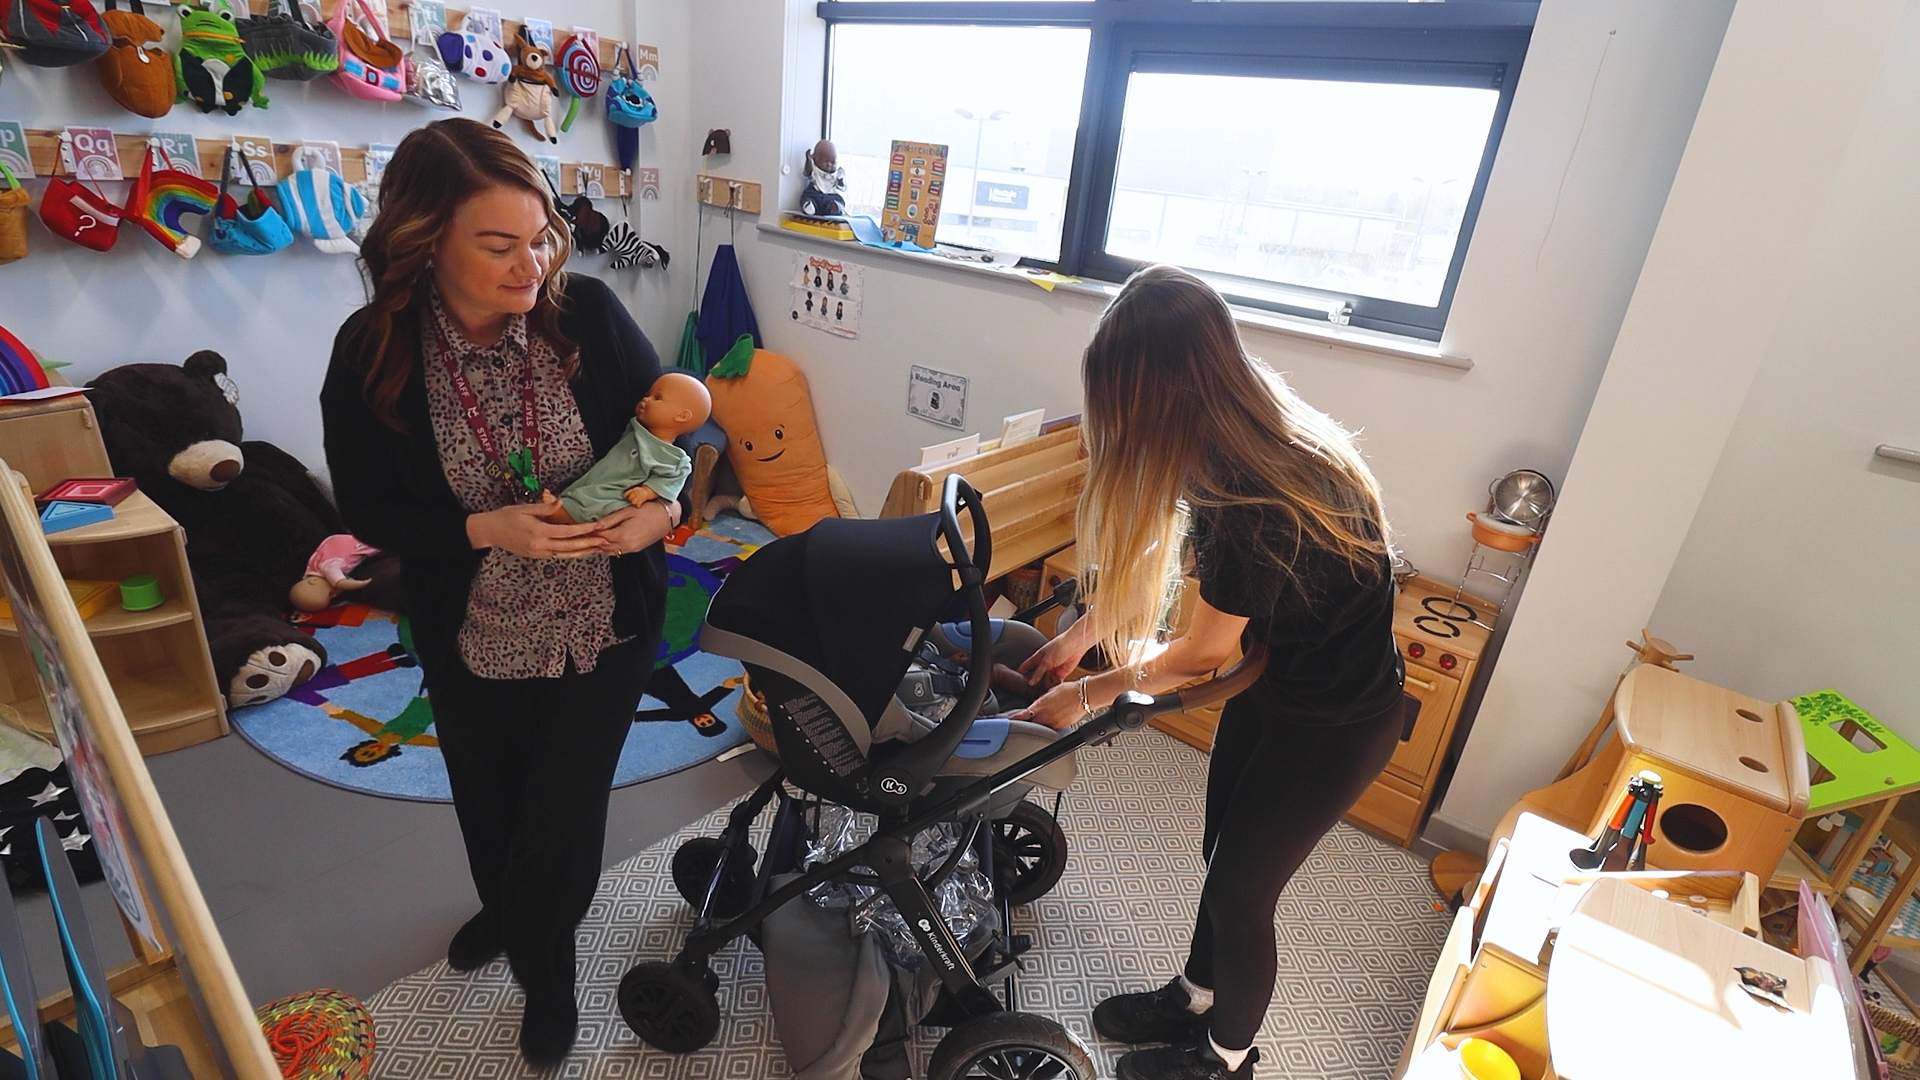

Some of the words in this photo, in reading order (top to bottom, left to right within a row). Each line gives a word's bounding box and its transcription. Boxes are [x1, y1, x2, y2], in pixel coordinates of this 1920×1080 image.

[639, 48, 658, 62] Mm
[0, 128, 16, 148] p
[74, 133, 114, 157] Qq
[161, 138, 188, 155] Rr
[242, 140, 268, 158] Ss
[587, 165, 602, 181] Yy
[643, 171, 658, 183] Zz
[453, 371, 471, 398] STAFF
[915, 372, 942, 389] Reading
[943, 380, 961, 392] Area
[526, 401, 534, 427] STAFF
[476, 426, 494, 453] STAFF
[927, 931, 956, 972] Kinderkraft
